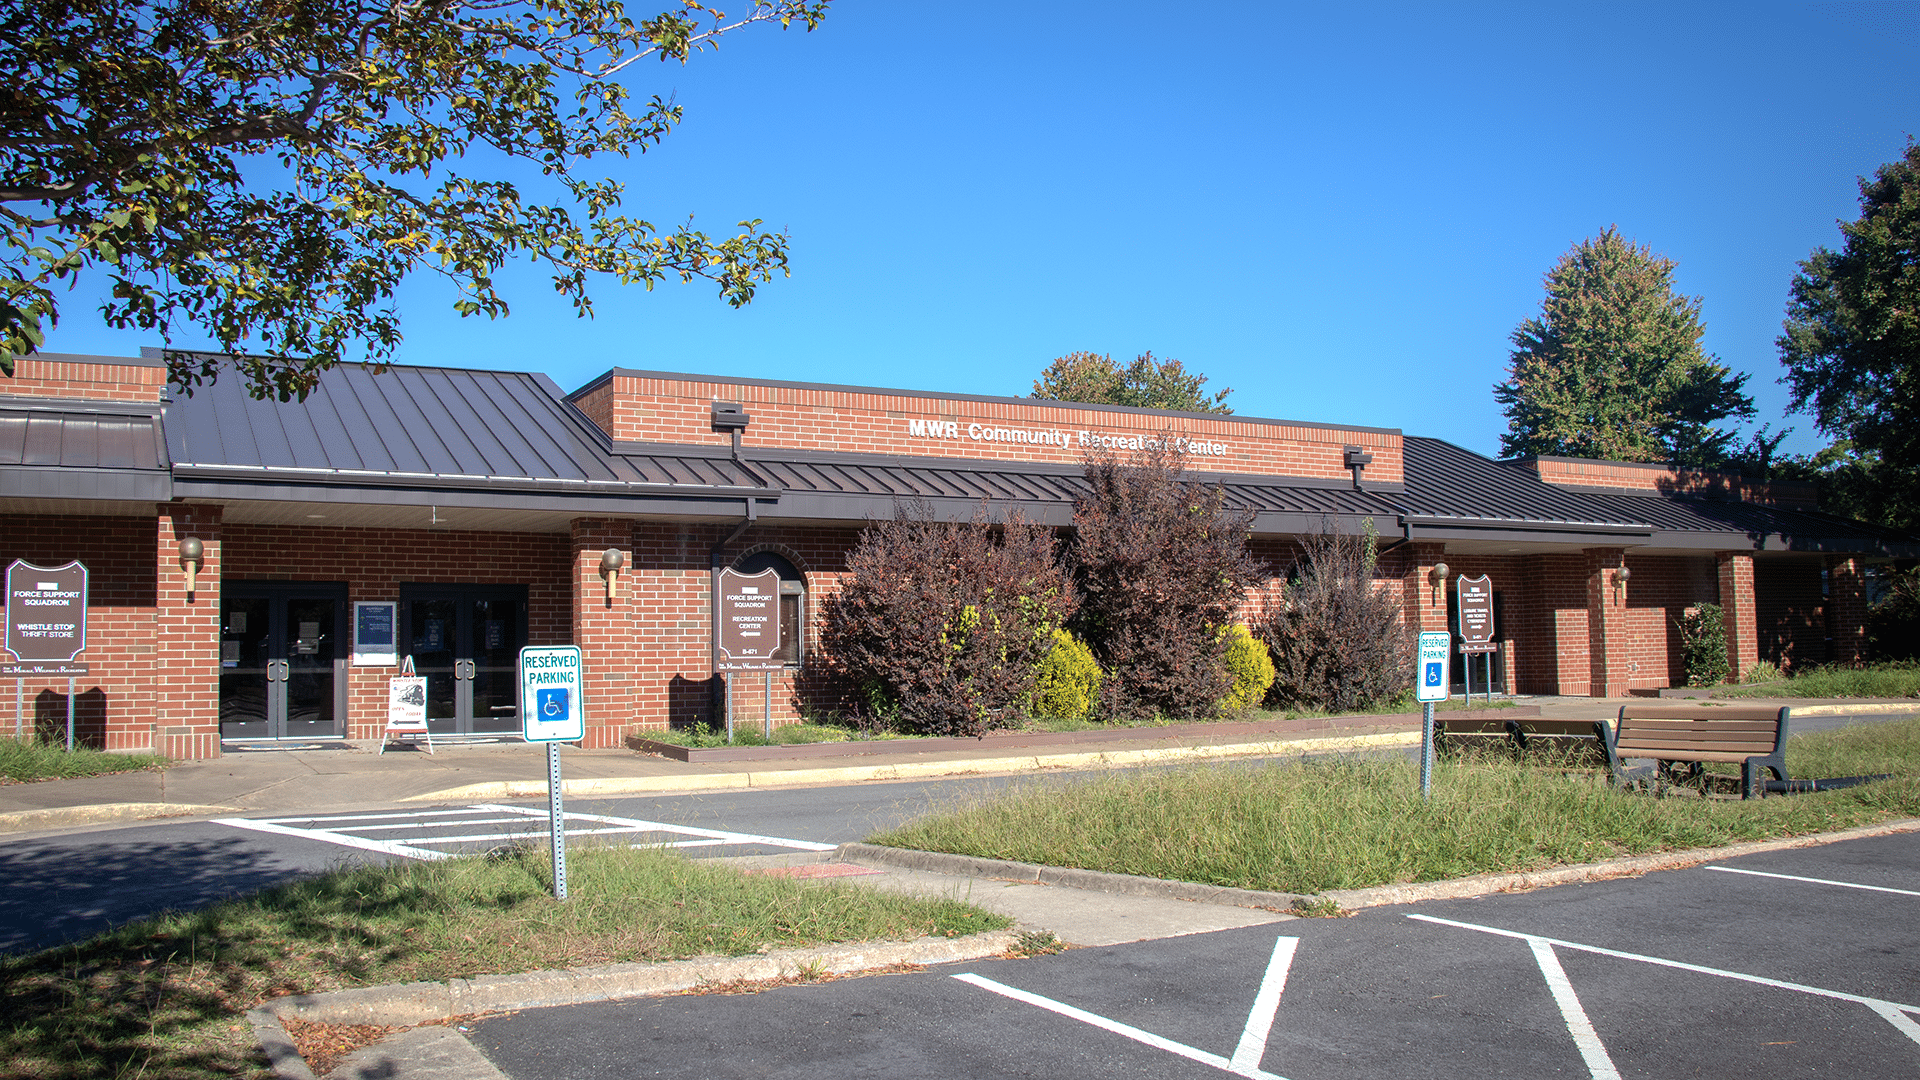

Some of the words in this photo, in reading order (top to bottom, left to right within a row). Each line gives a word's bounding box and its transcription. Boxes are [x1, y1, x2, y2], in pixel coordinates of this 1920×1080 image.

[909, 419, 958, 439] MWR
[968, 423, 1071, 449] Community
[1175, 436, 1228, 456] Center
[1422, 638, 1448, 647] RESERVED
[1423, 650, 1446, 659] PARKING
[525, 656, 577, 668] RESERVED
[529, 671, 574, 684] PARKING
